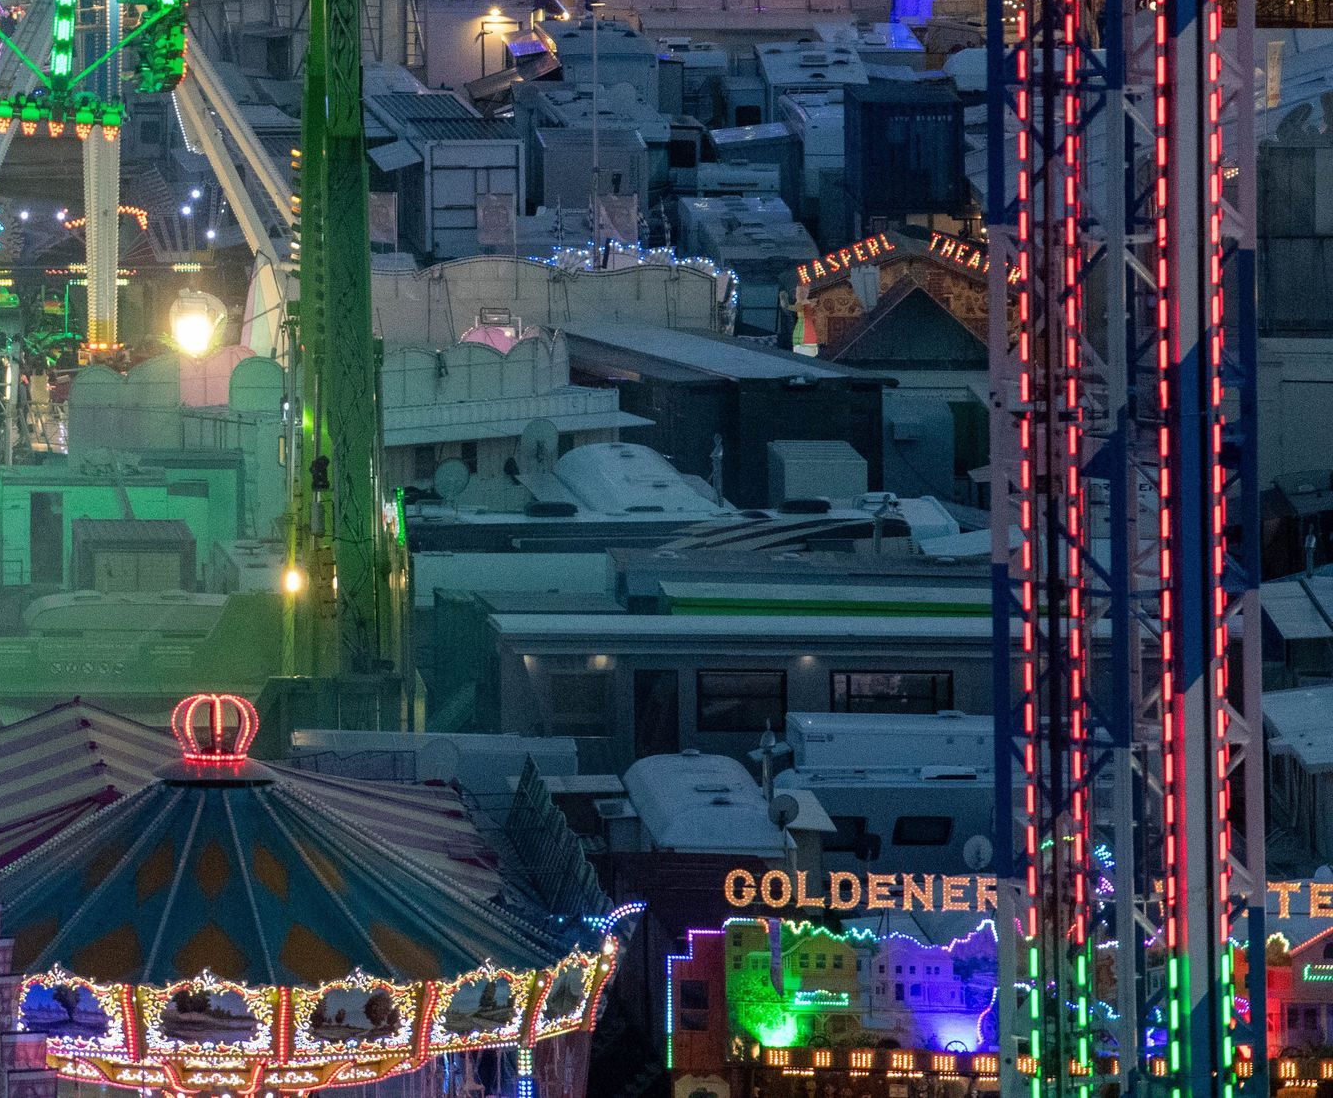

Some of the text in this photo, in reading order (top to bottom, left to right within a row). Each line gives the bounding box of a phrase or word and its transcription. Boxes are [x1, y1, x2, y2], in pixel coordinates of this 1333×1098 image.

[797, 232, 1021, 285] KASPERL THEATR
[724, 869, 998, 912] GOLDENER
